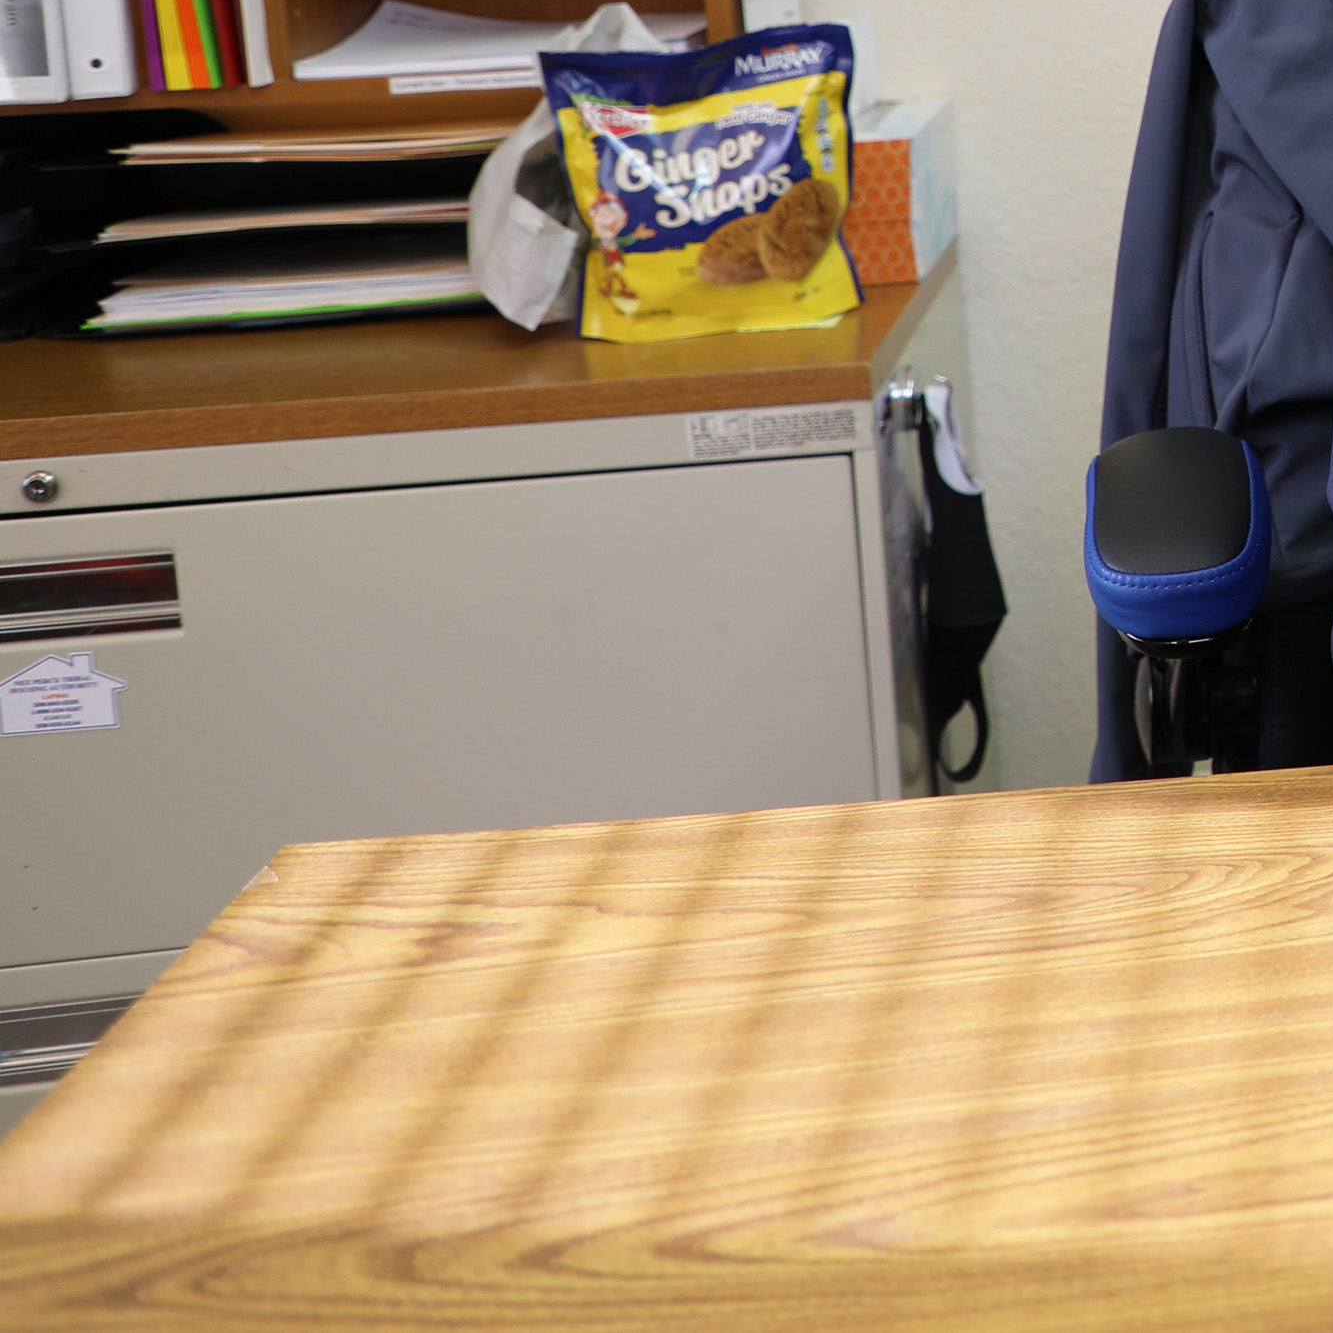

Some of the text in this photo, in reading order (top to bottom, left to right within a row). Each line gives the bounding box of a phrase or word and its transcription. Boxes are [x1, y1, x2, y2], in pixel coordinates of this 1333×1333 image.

[734, 47, 825, 77] MURRAY
[614, 129, 767, 193] Ginger
[654, 162, 795, 228] Snaps
